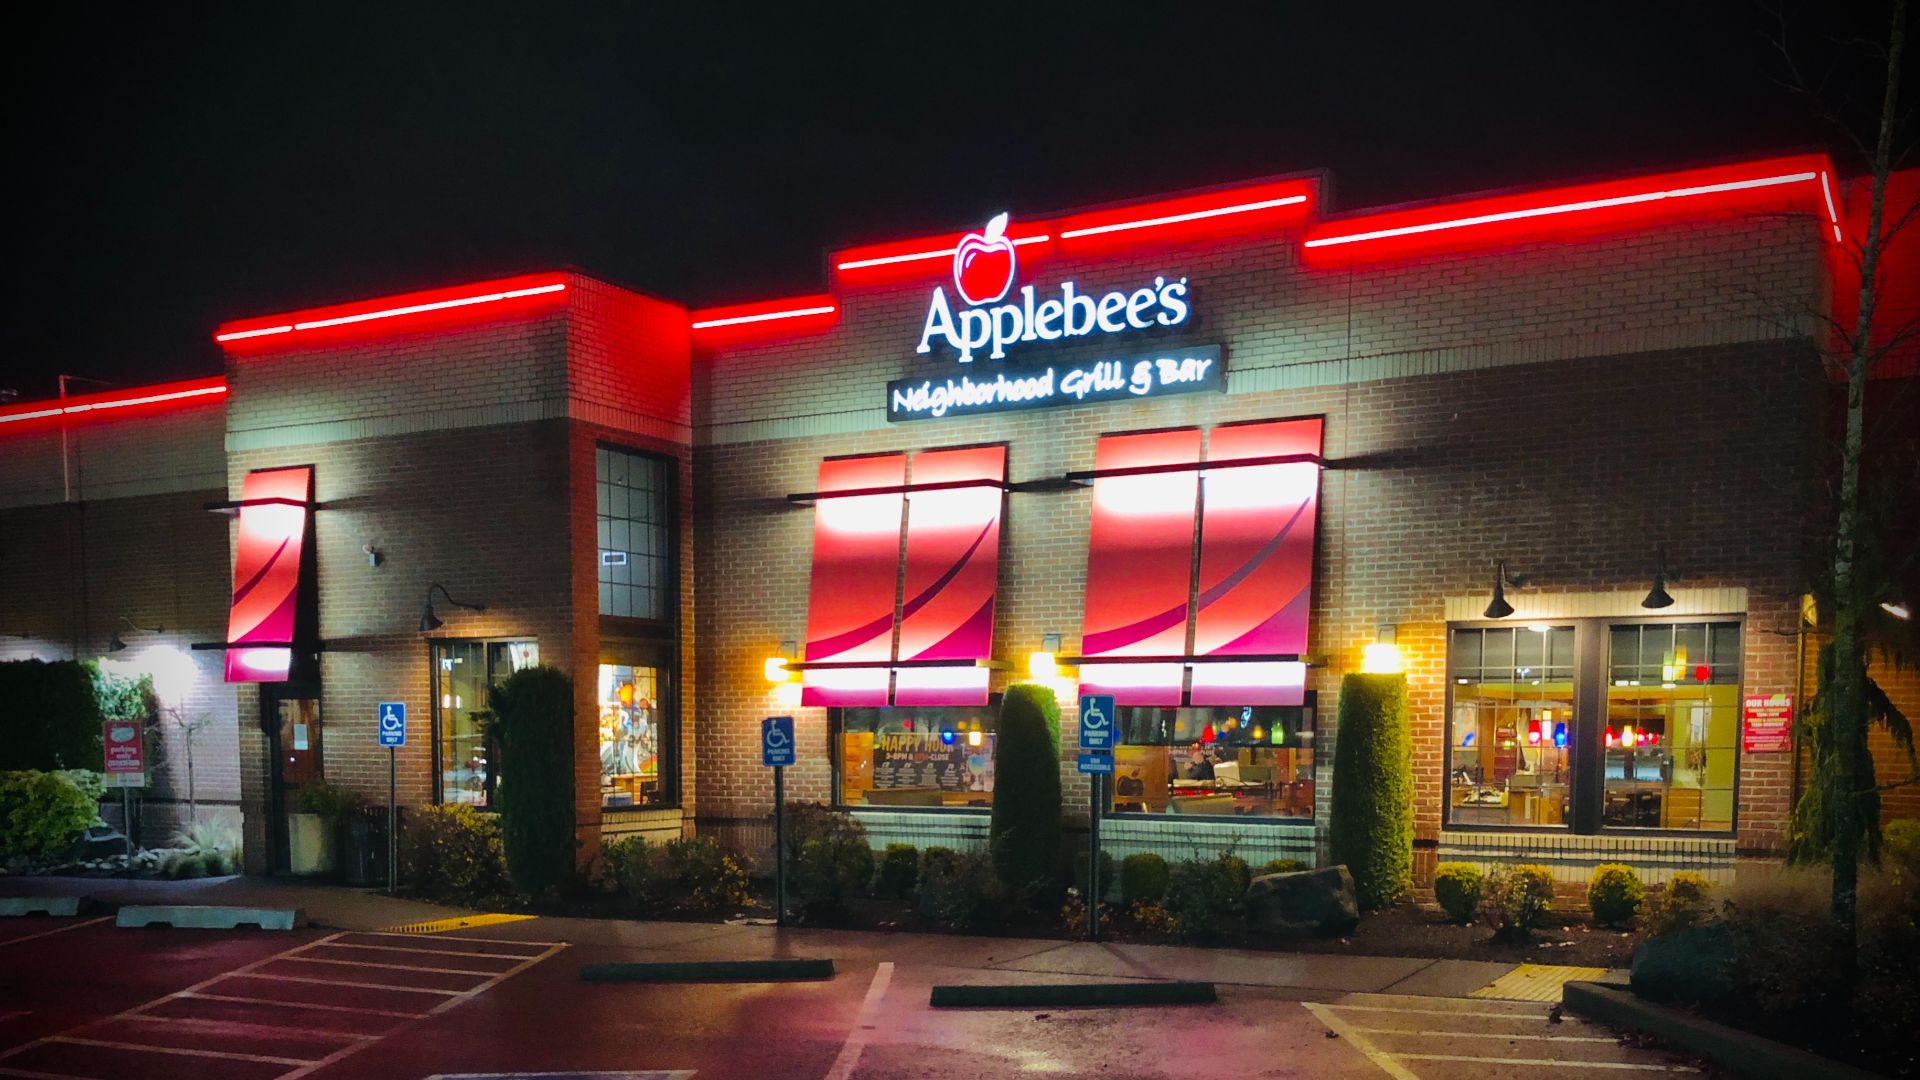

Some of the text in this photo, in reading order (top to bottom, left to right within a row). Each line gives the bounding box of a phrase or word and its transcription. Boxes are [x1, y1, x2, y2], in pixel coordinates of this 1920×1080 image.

[916, 276, 1188, 362] Applebee's
[893, 367, 1053, 416] Neighborhood
[1059, 360, 1125, 399] Grill
[1155, 357, 1212, 385] Bar
[1746, 699, 1762, 707] OUR
[881, 735, 921, 752] HAPPY
